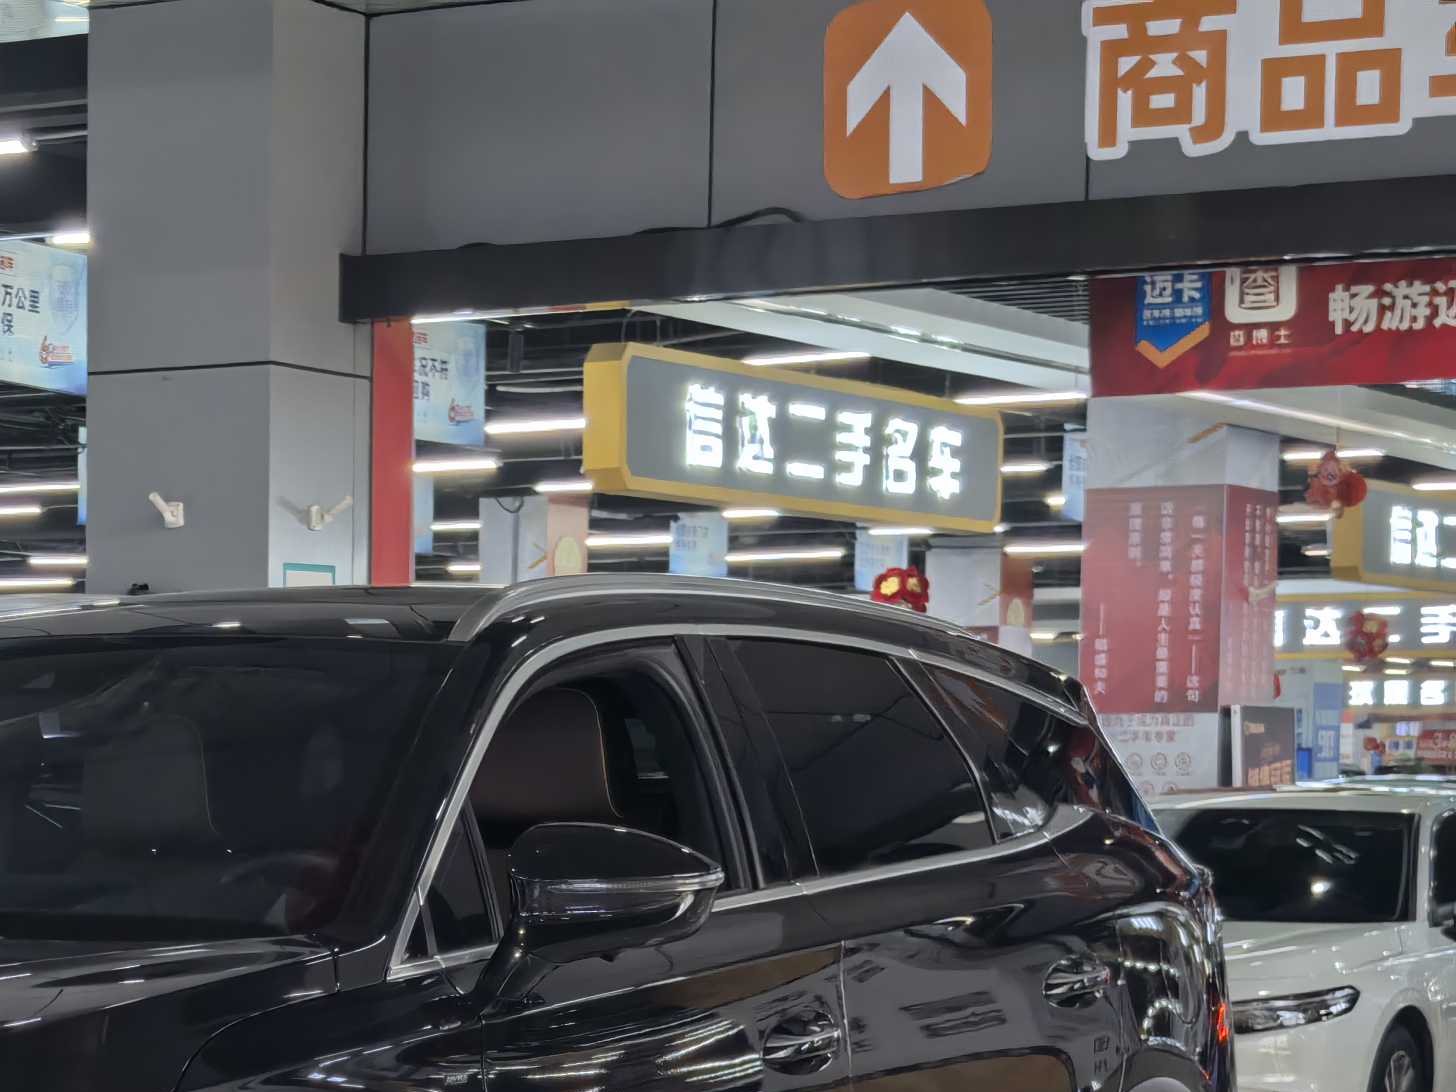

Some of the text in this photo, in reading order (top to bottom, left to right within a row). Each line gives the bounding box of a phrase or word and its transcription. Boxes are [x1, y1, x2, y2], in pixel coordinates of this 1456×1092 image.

[685, 383, 963, 500] 信达二手名车
